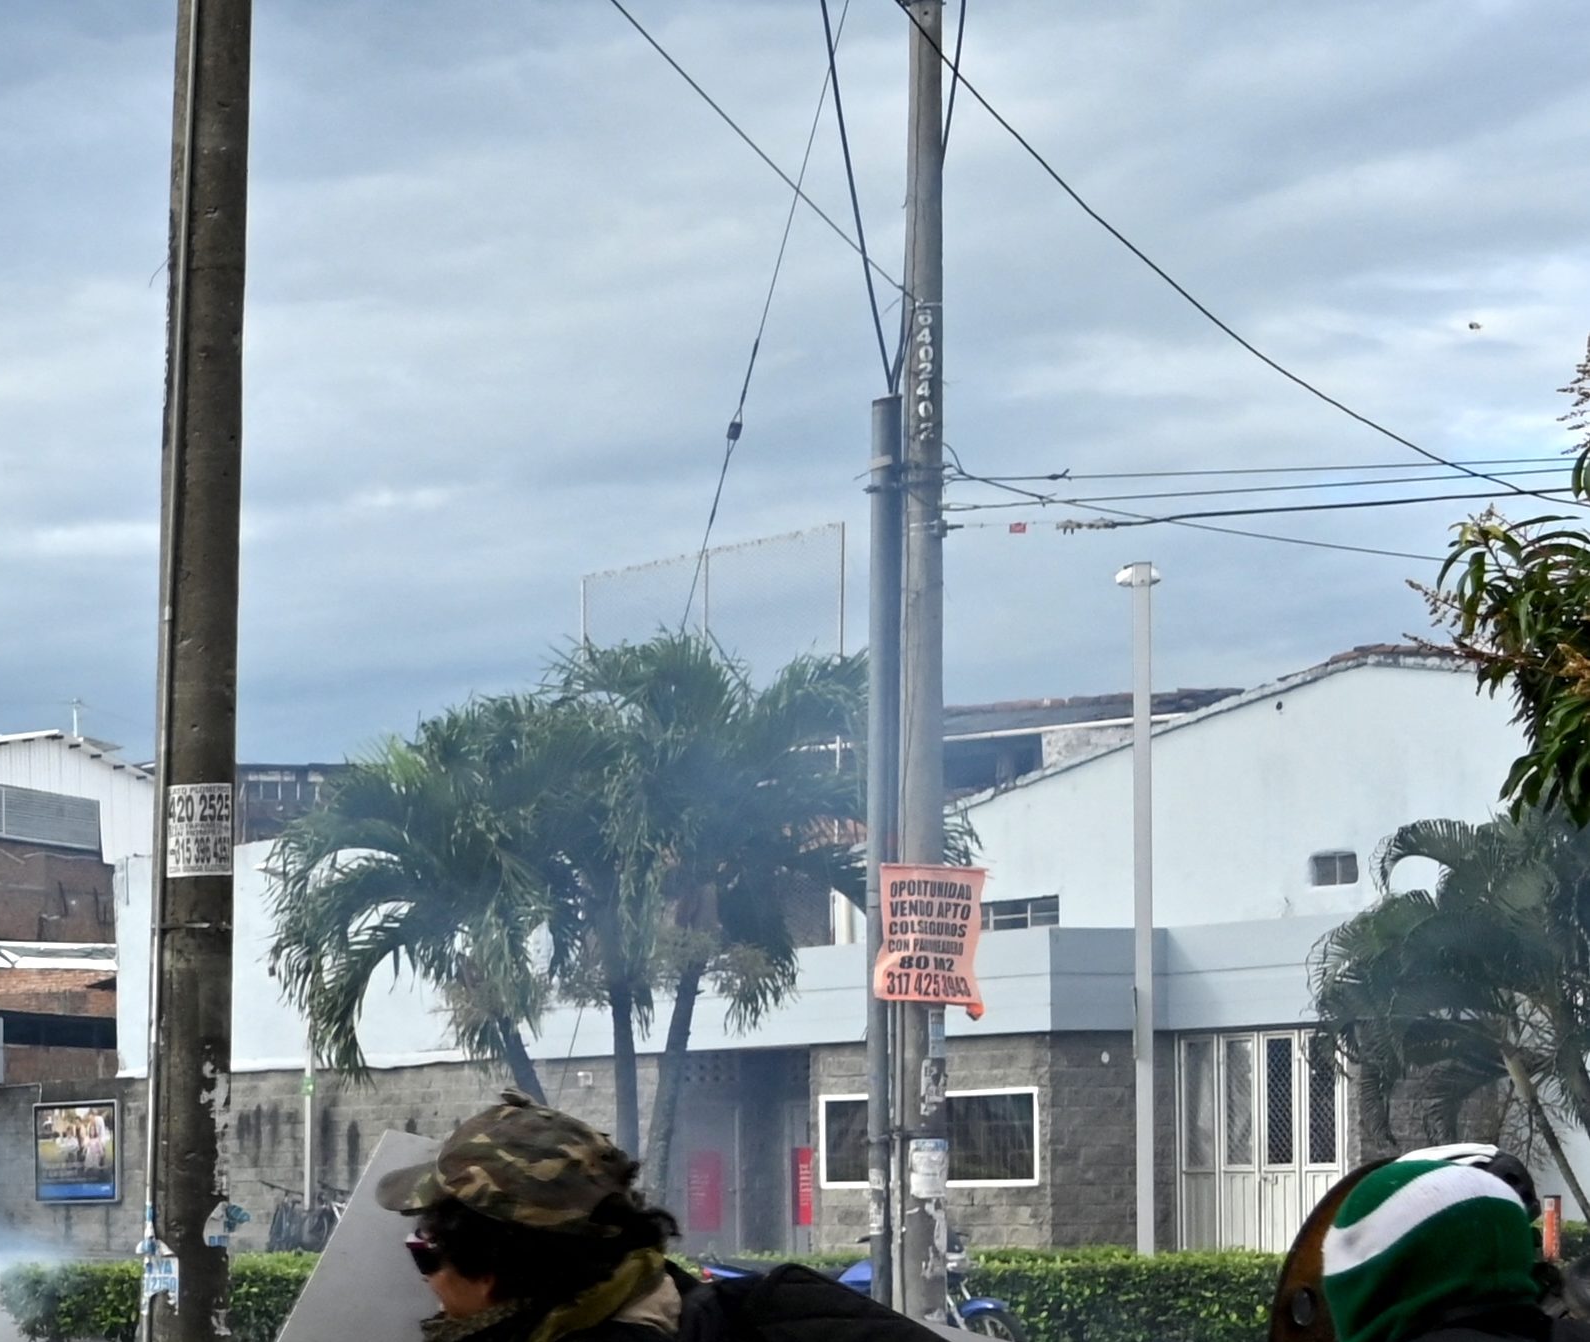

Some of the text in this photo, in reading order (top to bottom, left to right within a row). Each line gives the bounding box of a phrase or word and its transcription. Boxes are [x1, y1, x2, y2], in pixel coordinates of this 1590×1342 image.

[168, 793, 230, 824] 420 2525
[890, 879, 972, 901] OPORTUNIDAD
[890, 900, 972, 921] VENDO APTO
[889, 919, 968, 938] COLSEGUROS
[888, 938, 910, 953] CON
[899, 955, 930, 970] 80
[886, 971, 911, 995] 317
[914, 972, 941, 997] 425
